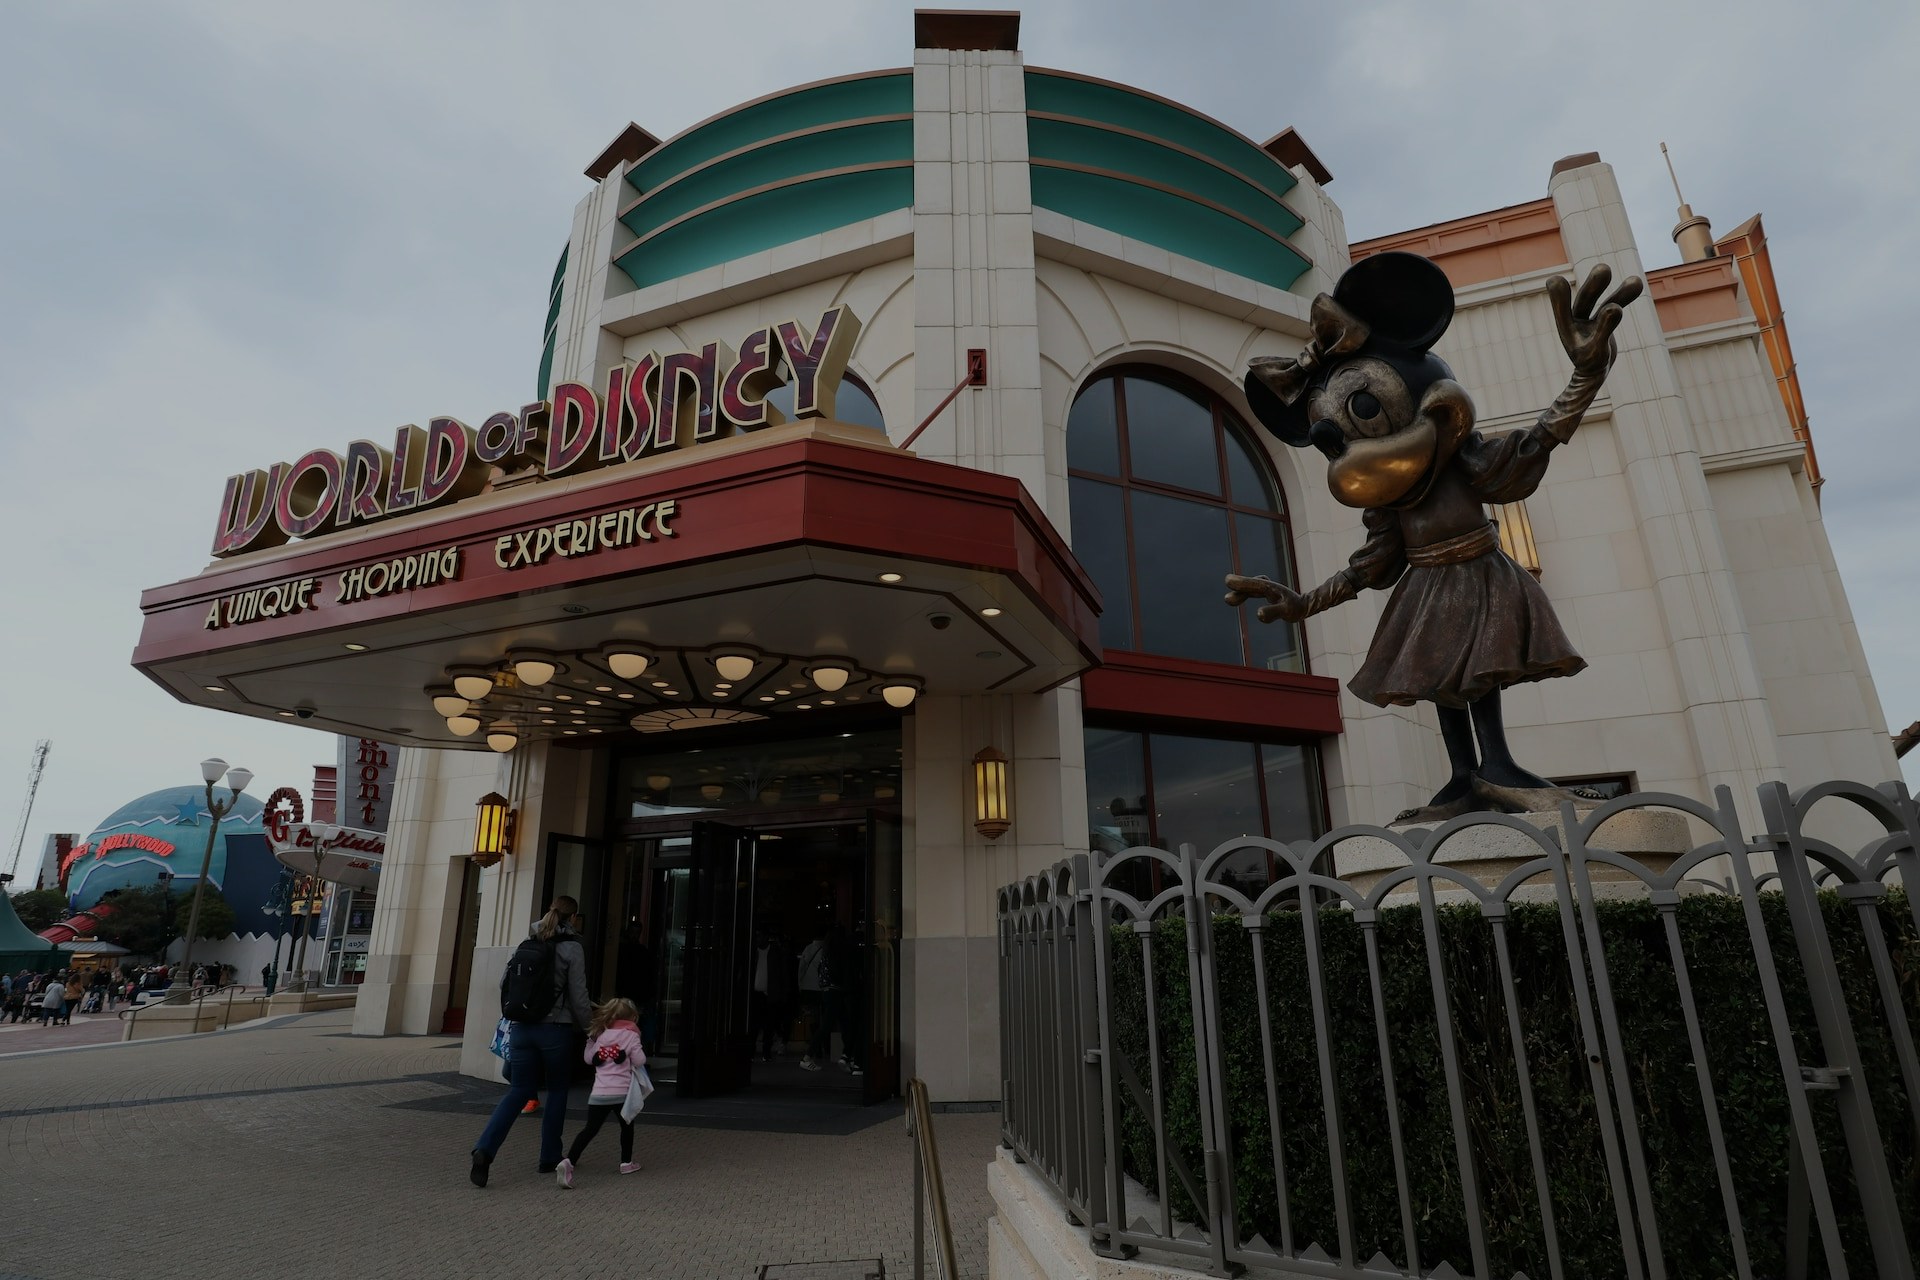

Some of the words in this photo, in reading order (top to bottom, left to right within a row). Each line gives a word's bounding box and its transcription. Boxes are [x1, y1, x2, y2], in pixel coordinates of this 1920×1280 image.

[210, 416, 470, 557] WORLD
[474, 400, 548, 463] OF
[544, 304, 848, 476] DISNEY
[203, 598, 222, 630] A
[226, 578, 314, 624] UNIQUE
[336, 546, 458, 602] SHOPPING
[494, 500, 677, 569] EXPERIENCE
[95, 833, 176, 860] HOLLYWOOD
